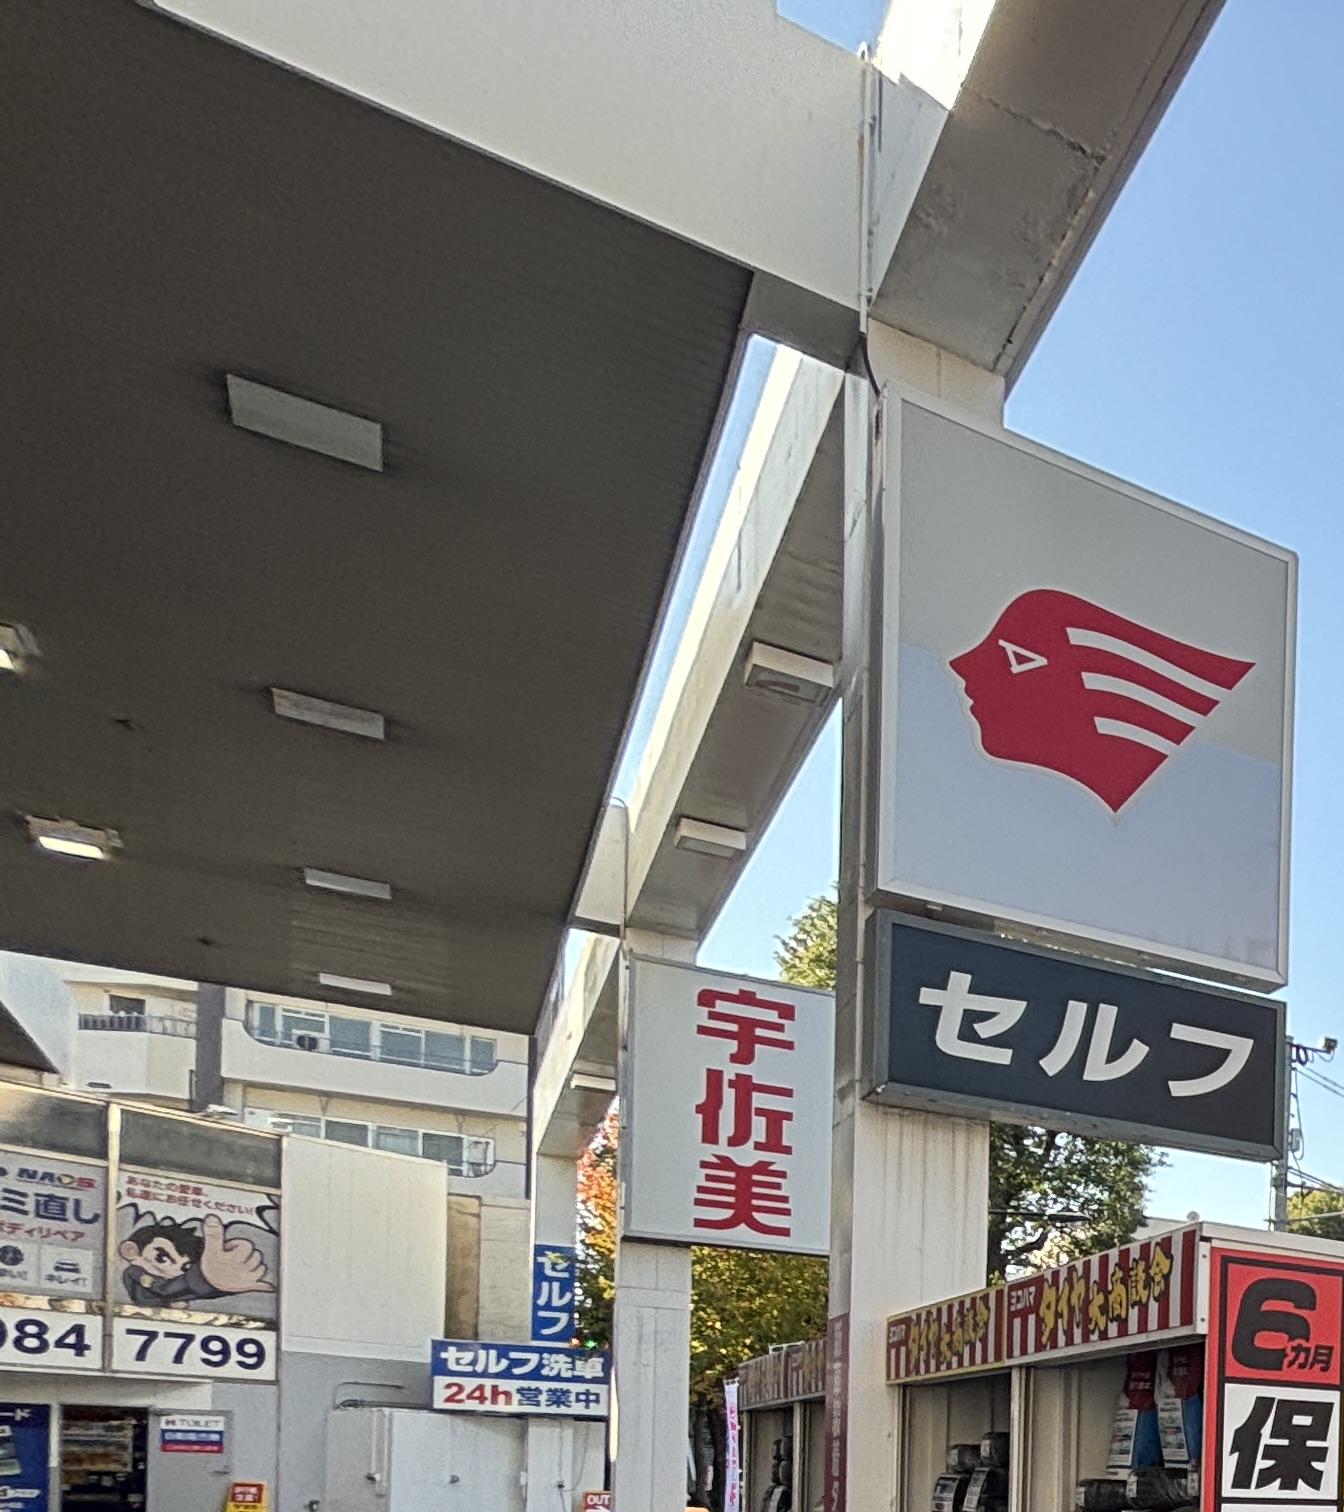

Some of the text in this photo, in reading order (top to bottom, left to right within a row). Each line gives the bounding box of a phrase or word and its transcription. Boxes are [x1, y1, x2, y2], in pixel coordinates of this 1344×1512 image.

[919, 970, 1255, 1097] セルフ
[693, 988, 796, 1237] 宇佐美
[537, 1251, 572, 1335] セルフ
[125, 1327, 266, 1370] 7799
[440, 1345, 604, 1380] セルフ洗車
[443, 1382, 601, 1410] 24h営業中
[587, 1494, 611, 1505] OUT
